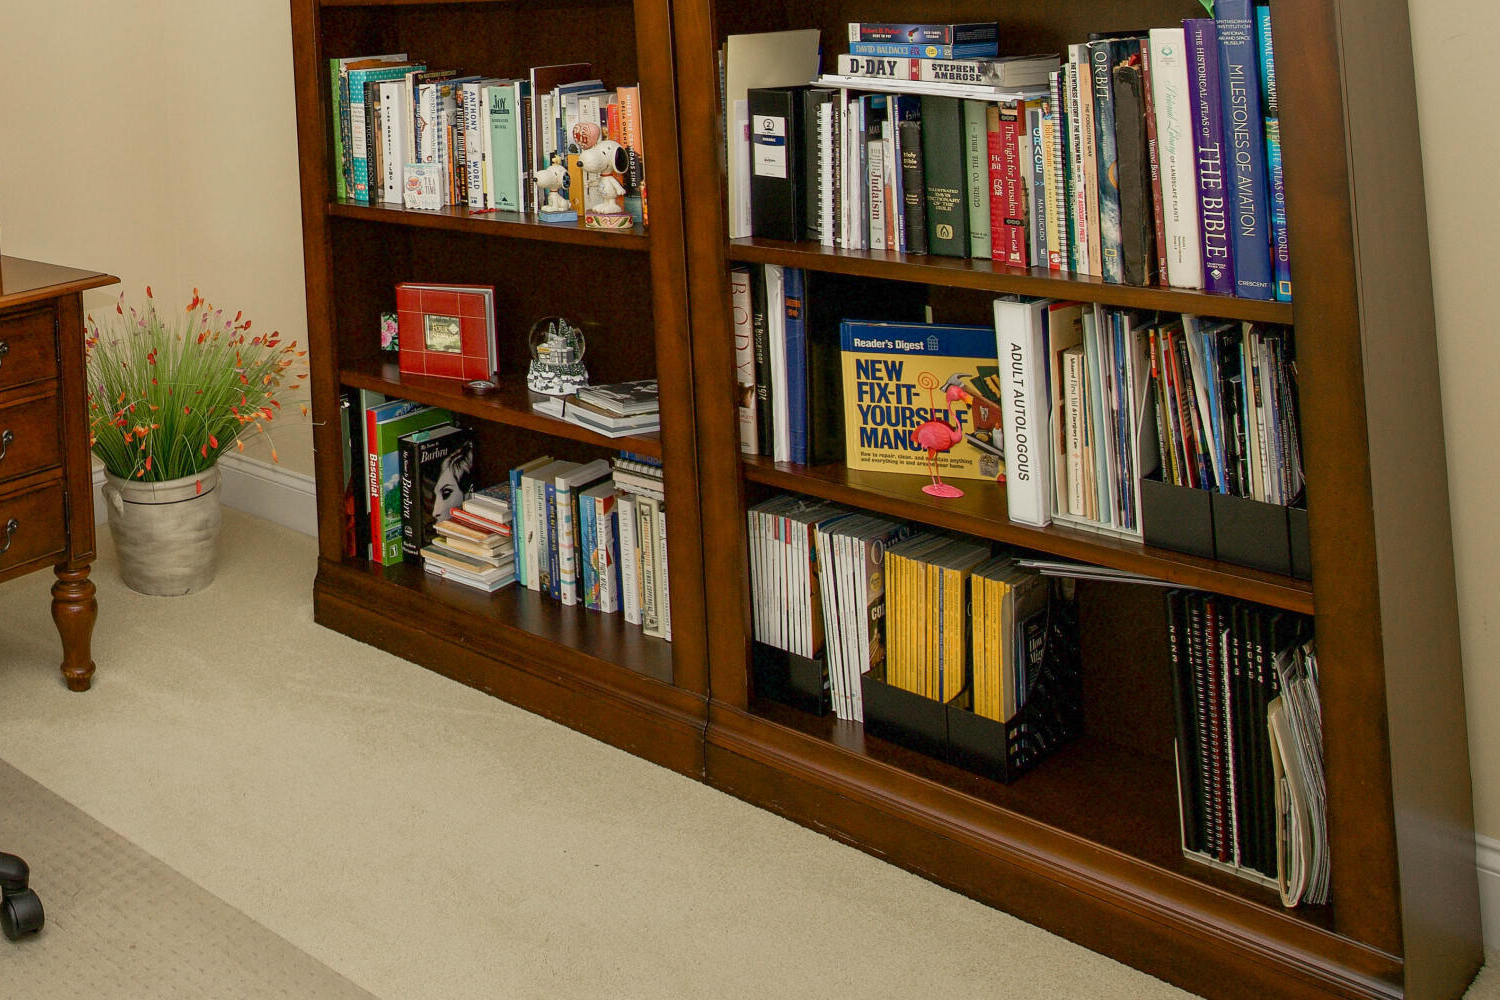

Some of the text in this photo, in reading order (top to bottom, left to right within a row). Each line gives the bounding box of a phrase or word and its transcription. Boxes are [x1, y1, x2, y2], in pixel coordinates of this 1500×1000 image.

[1262, 15, 1272, 56] NATIONAL
[876, 46, 908, 54] BALDACCI
[850, 58, 898, 76] D-DAY
[932, 64, 975, 74] STEPHEN
[934, 72, 982, 82] AMBROSE
[1094, 51, 1108, 100] ORBIT
[1196, 47, 1208, 98] HISTORICAL
[1266, 58, 1278, 112] GEOGRAPHIC
[470, 92, 478, 130] ANTHONY
[1200, 100, 1209, 126] ATLAS
[1005, 124, 1014, 141] The
[1202, 128, 1210, 138] OF
[1005, 142, 1015, 163] Fight
[1034, 127, 1044, 173] GRACE
[1230, 64, 1255, 237] MILESTONES OF AVIATION
[973, 173, 980, 182] TO
[1273, 164, 1284, 190] ATLAS
[872, 172, 882, 220] Judaism
[1006, 177, 1018, 216] Jerusalem
[1198, 141, 1228, 258] THE BIBLE
[1276, 192, 1285, 204] OF
[1276, 208, 1286, 225] THE
[1278, 228, 1288, 262] WORLD
[1238, 280, 1268, 288] CRESCENT
[754, 313, 764, 364] The Buccaneer
[854, 338, 924, 351] Reader's Digest
[856, 358, 904, 382] NEW
[857, 381, 920, 406] FIX-IT-
[1011, 343, 1030, 481] ADULT AUTOLOGOUS
[369, 454, 379, 498] Basquiat
